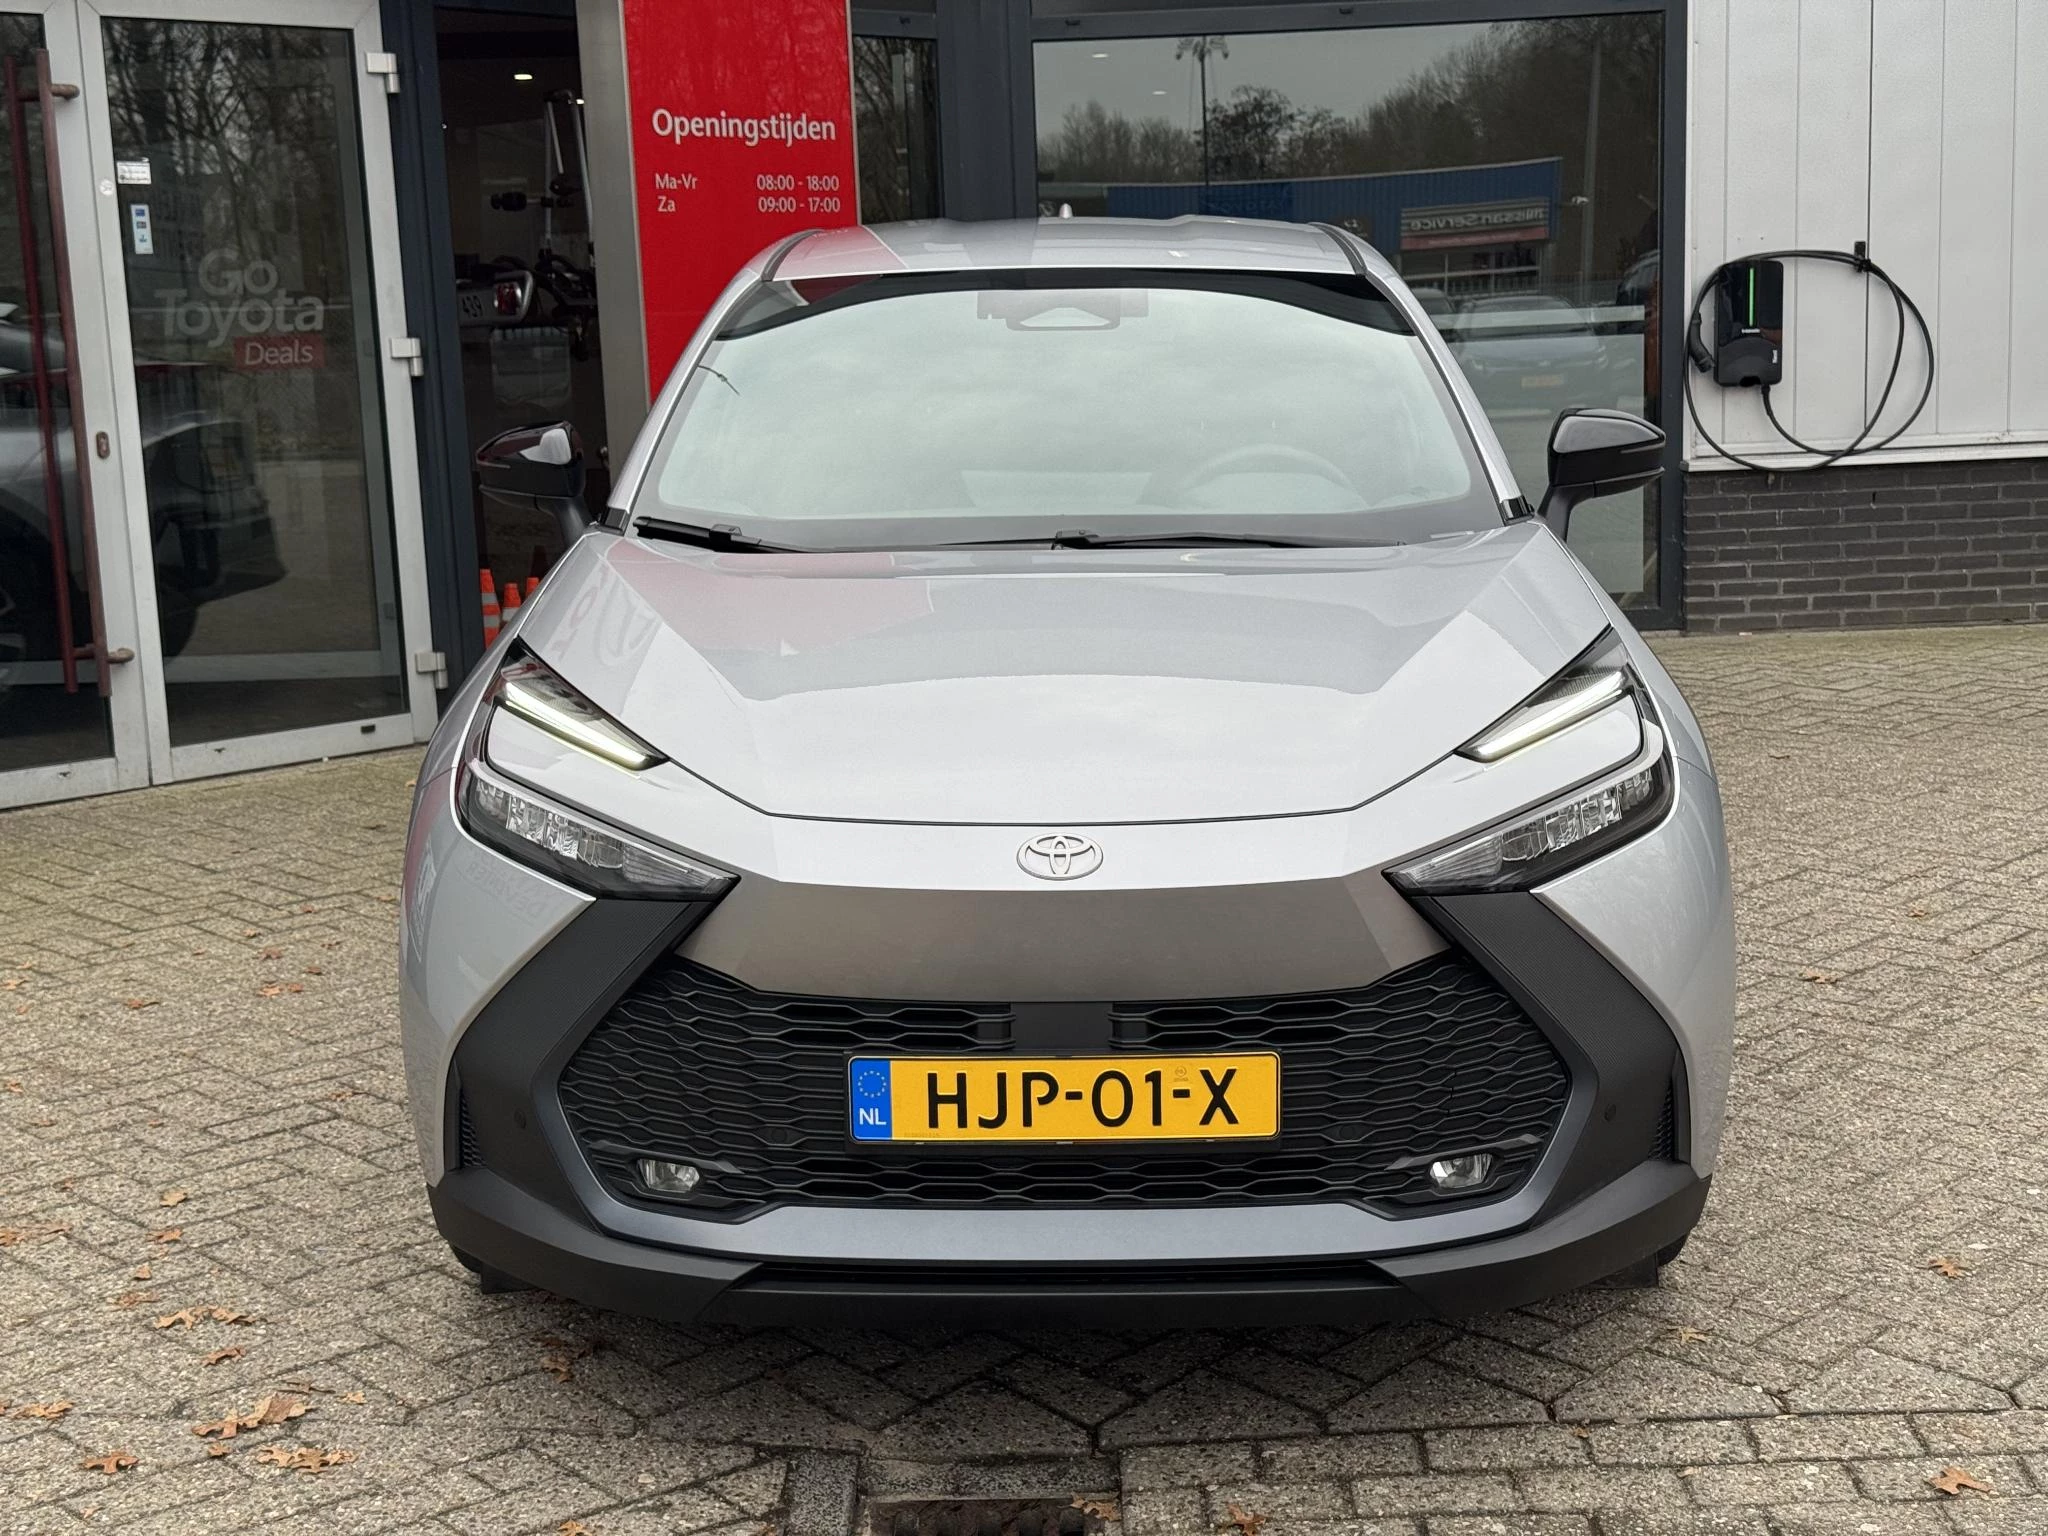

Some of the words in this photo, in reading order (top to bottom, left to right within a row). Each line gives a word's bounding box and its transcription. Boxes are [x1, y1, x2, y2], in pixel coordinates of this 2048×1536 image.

[652, 108, 836, 147] Openingstijden
[655, 173, 697, 190] Ma-Vr
[757, 174, 794, 191] 08:00
[806, 175, 840, 191] 18:00
[657, 196, 676, 212] Za
[758, 196, 797, 213] 09:00
[808, 197, 841, 213] 17:00
[198, 248, 278, 295] Go
[153, 287, 324, 348] Toyota
[244, 340, 313, 365] Deals
[926, 1068, 1239, 1130] HJP-01-X
[858, 1107, 887, 1126] NL
